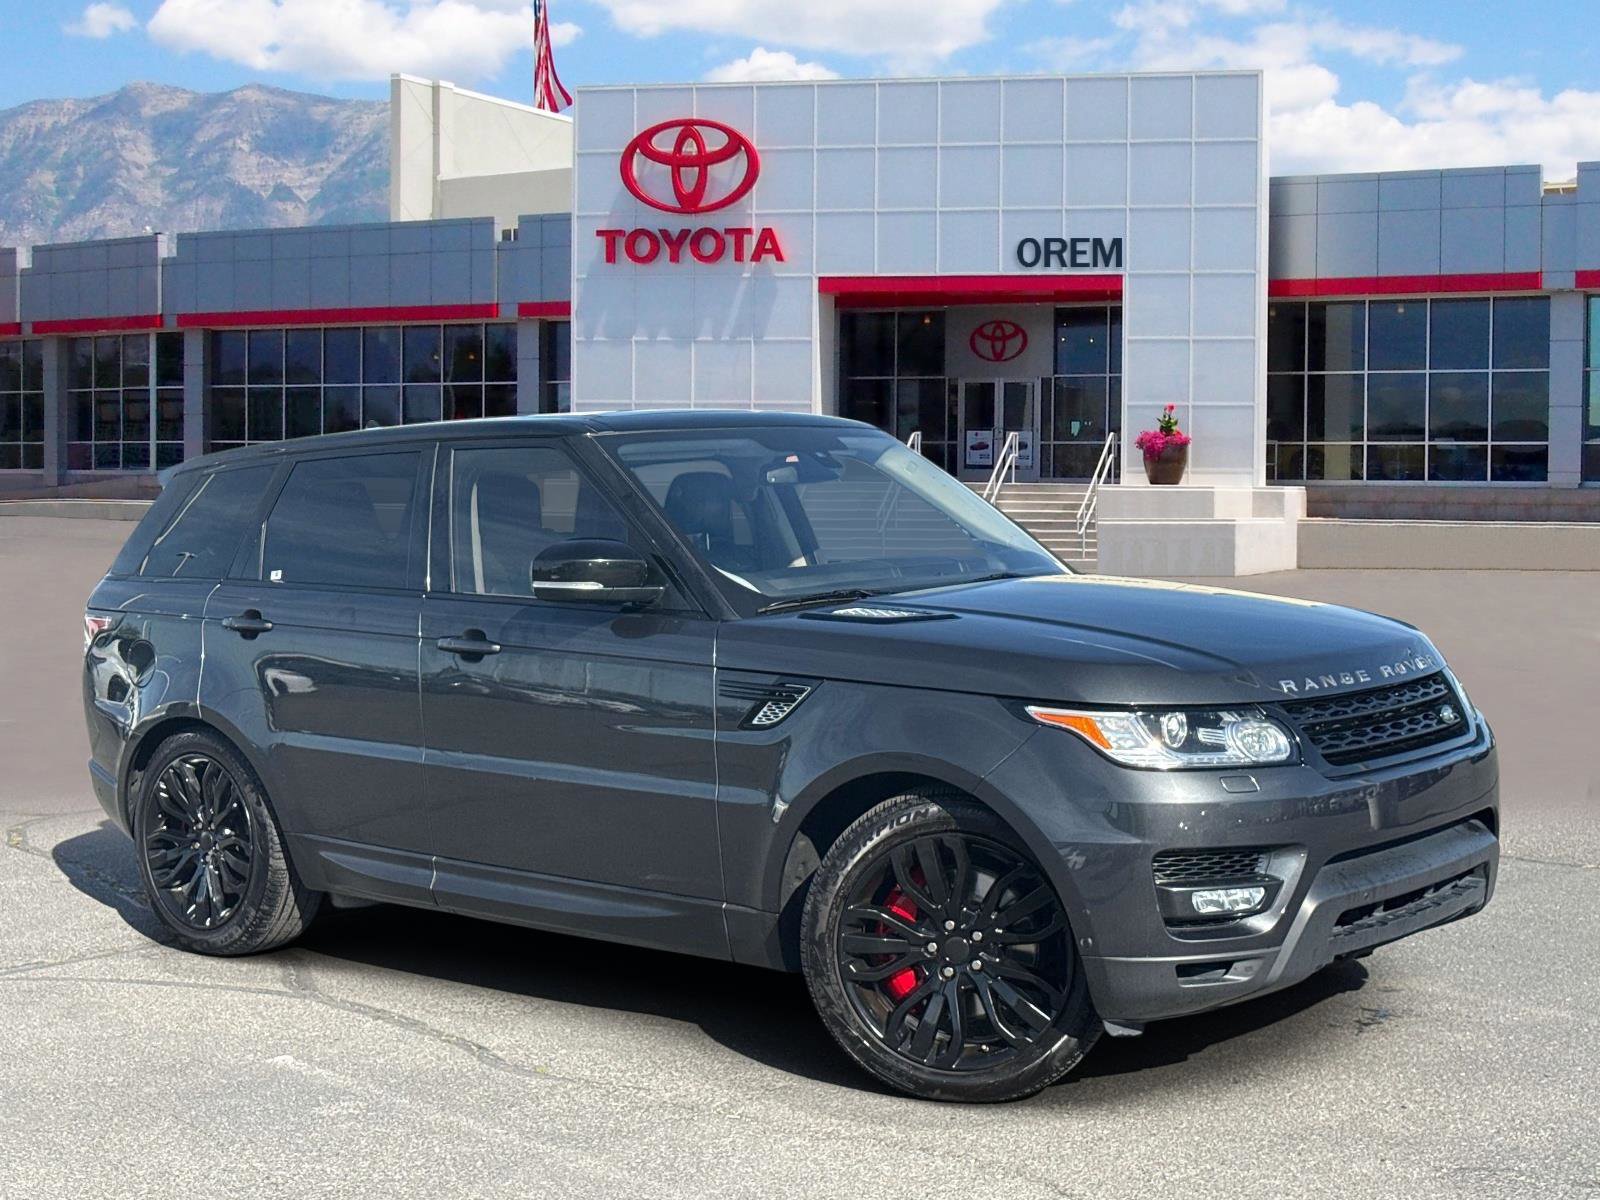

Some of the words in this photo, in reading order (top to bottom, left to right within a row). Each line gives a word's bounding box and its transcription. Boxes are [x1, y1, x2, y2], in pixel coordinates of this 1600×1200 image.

[596, 227, 785, 264] TOYOTA
[1016, 237, 1123, 268] OREM
[1279, 669, 1371, 693] RANGE
[1379, 654, 1435, 679] ROVER
